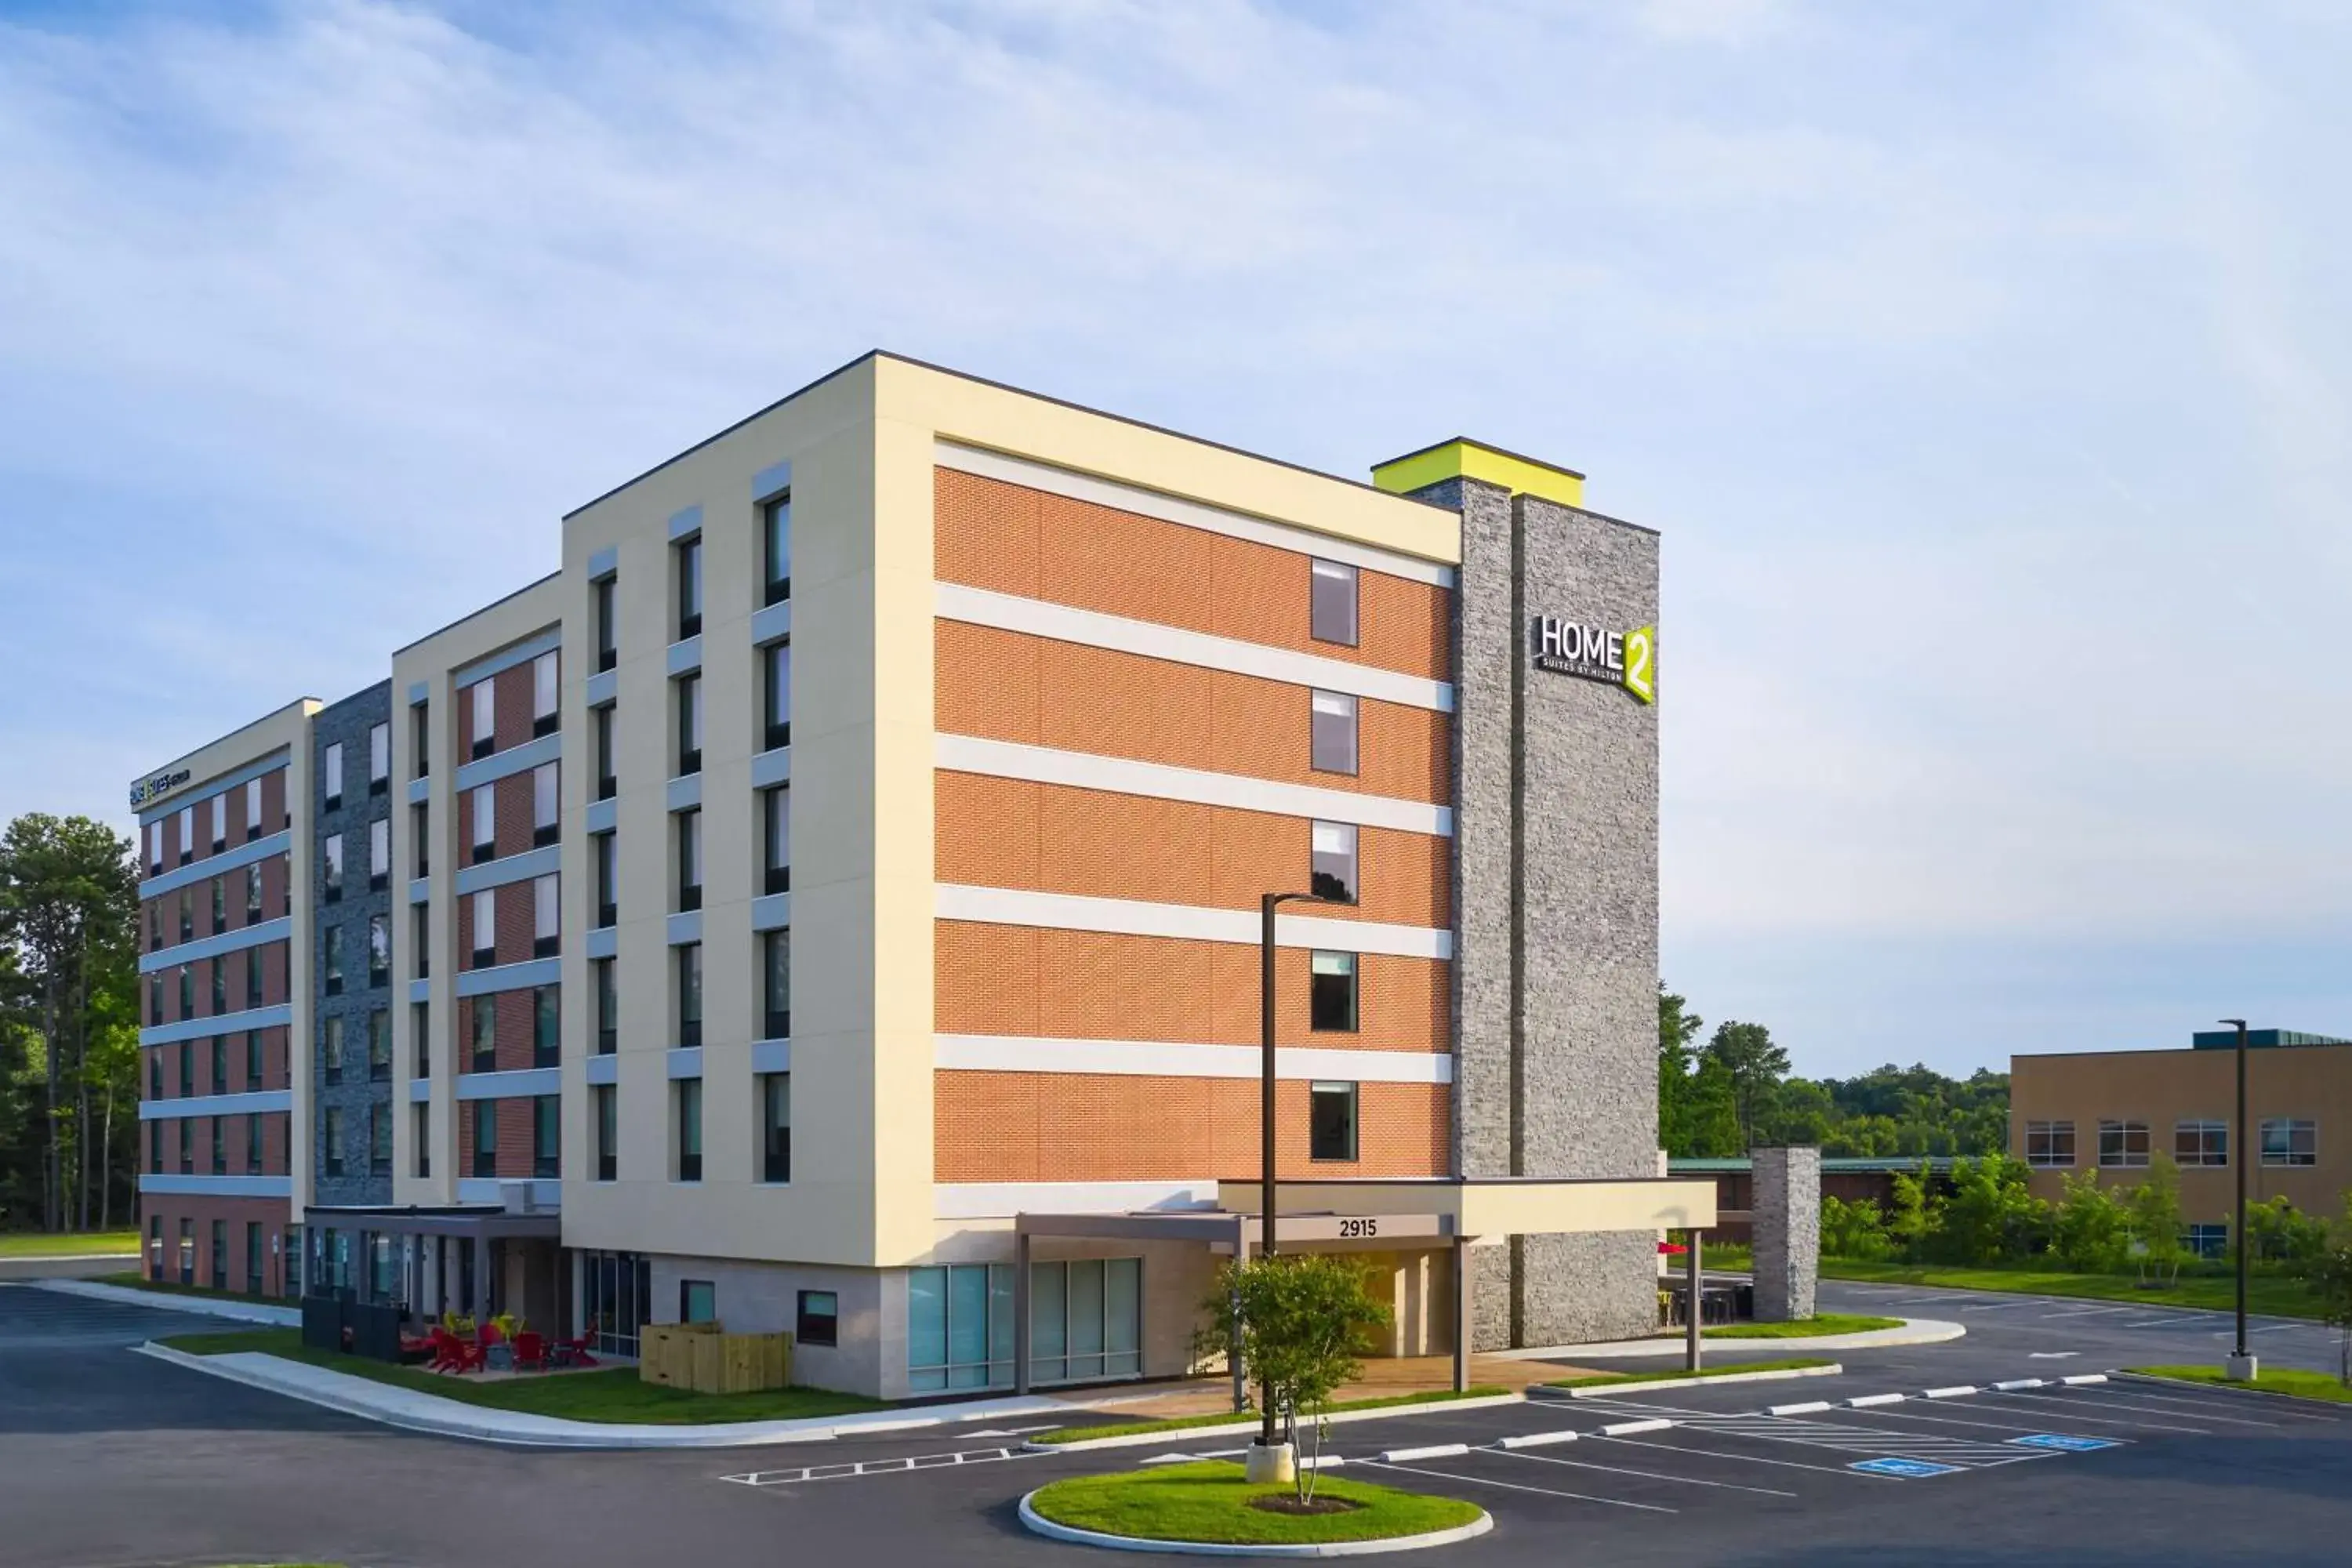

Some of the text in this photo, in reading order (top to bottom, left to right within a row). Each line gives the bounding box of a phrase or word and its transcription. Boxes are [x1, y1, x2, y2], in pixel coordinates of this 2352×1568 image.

[1542, 615, 1624, 670] HOME
[1544, 658, 1574, 672] SUITES
[1592, 669, 1622, 681] HILTON
[1340, 1219, 1377, 1236] 2915
